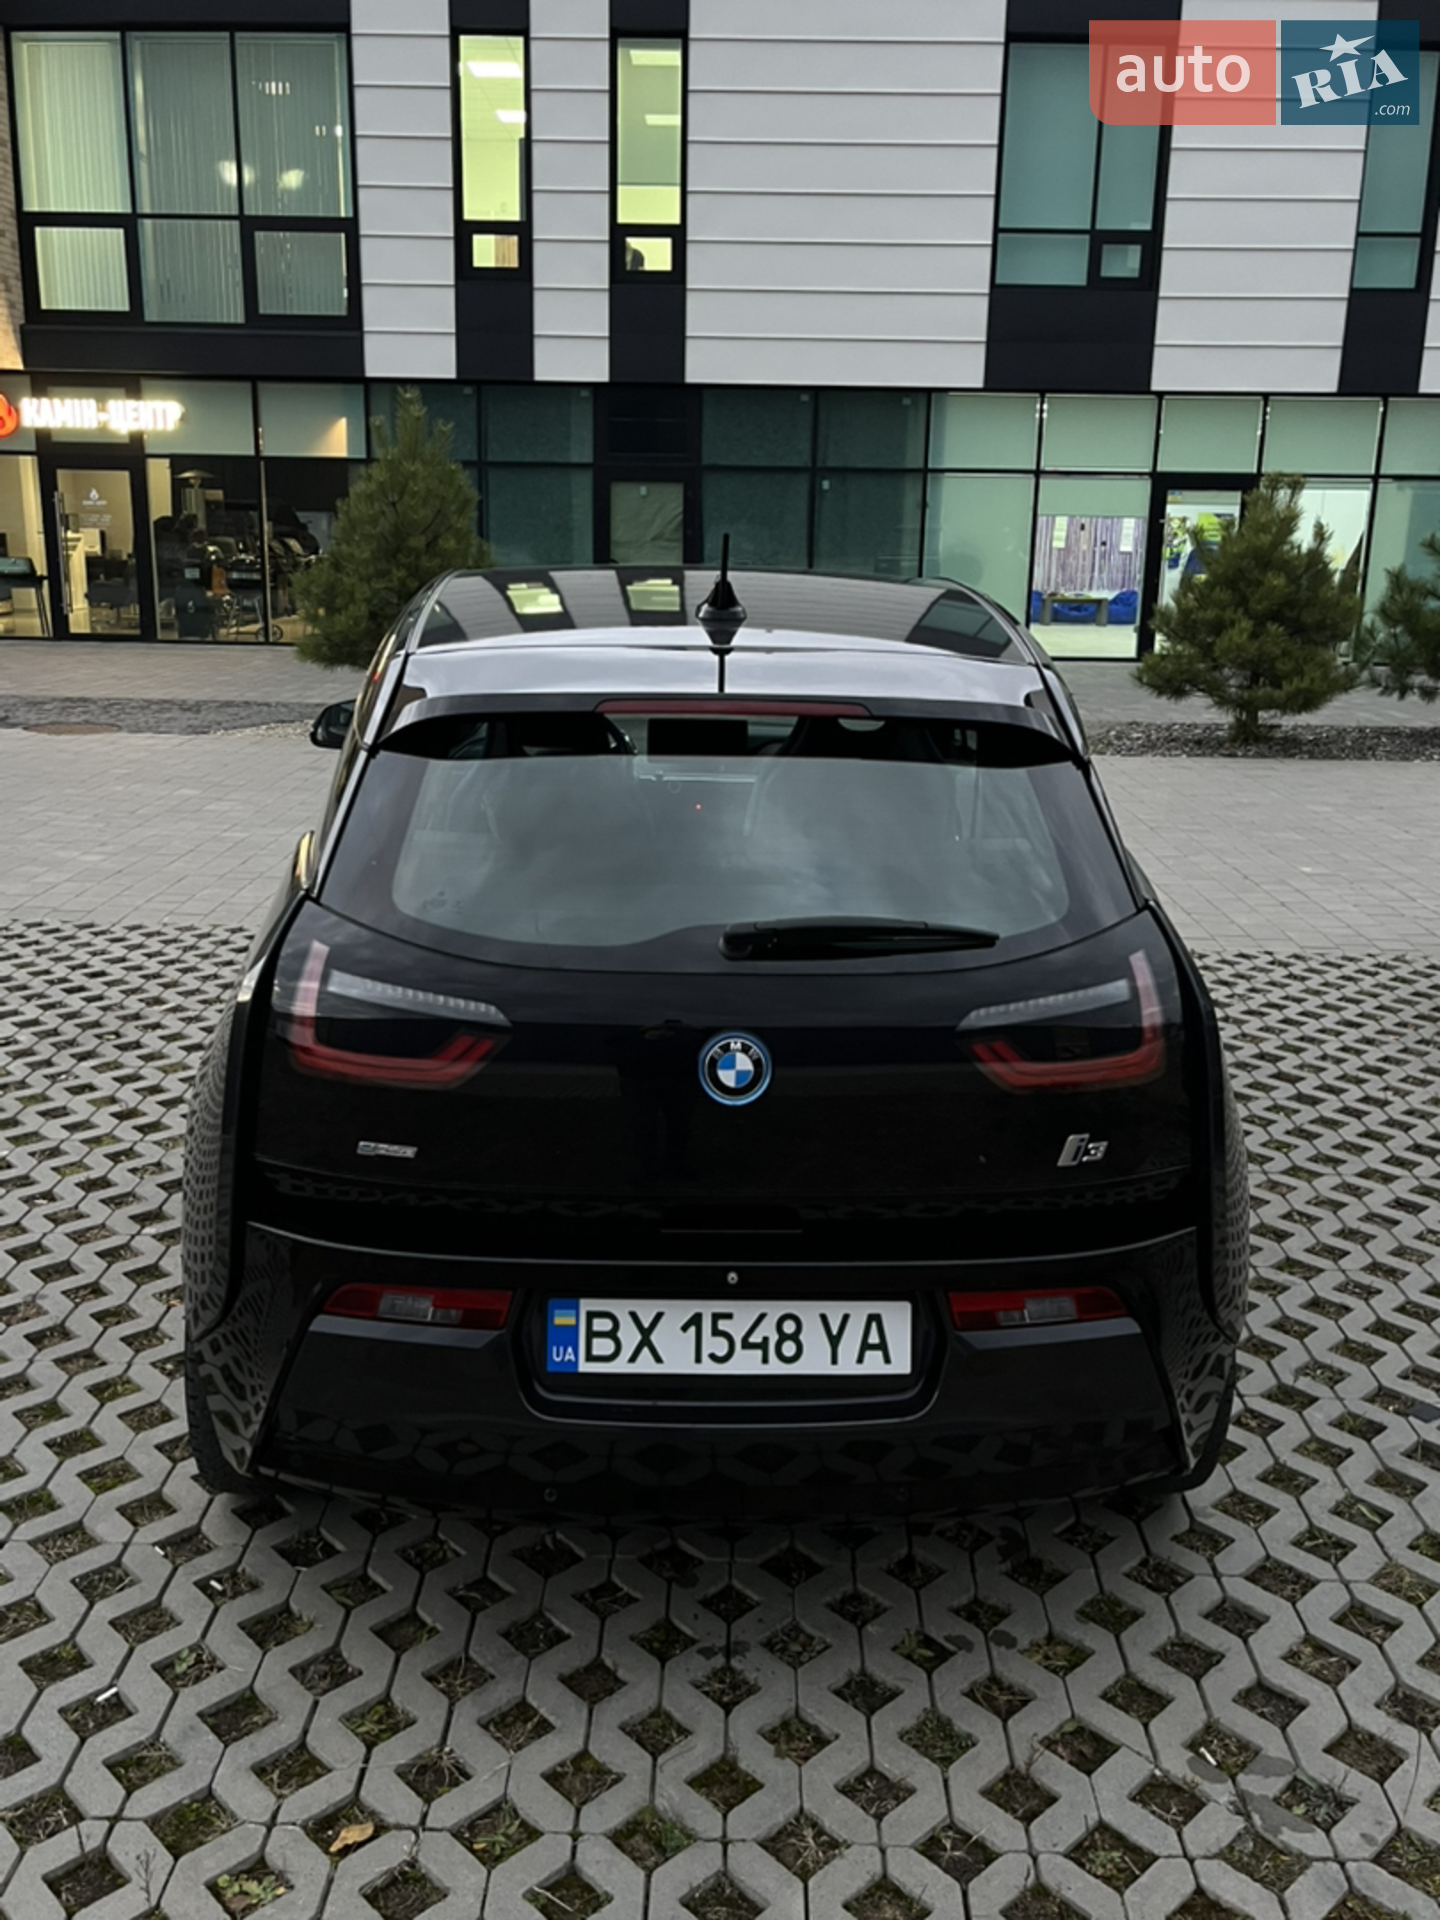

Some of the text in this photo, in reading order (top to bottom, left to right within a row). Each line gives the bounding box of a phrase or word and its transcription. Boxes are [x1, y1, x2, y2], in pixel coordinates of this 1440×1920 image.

[711, 1040, 760, 1061] BMW
[1057, 1133, 1108, 1167] i3
[584, 1310, 892, 1366] BX 1548 YA
[552, 1346, 576, 1363] UA
